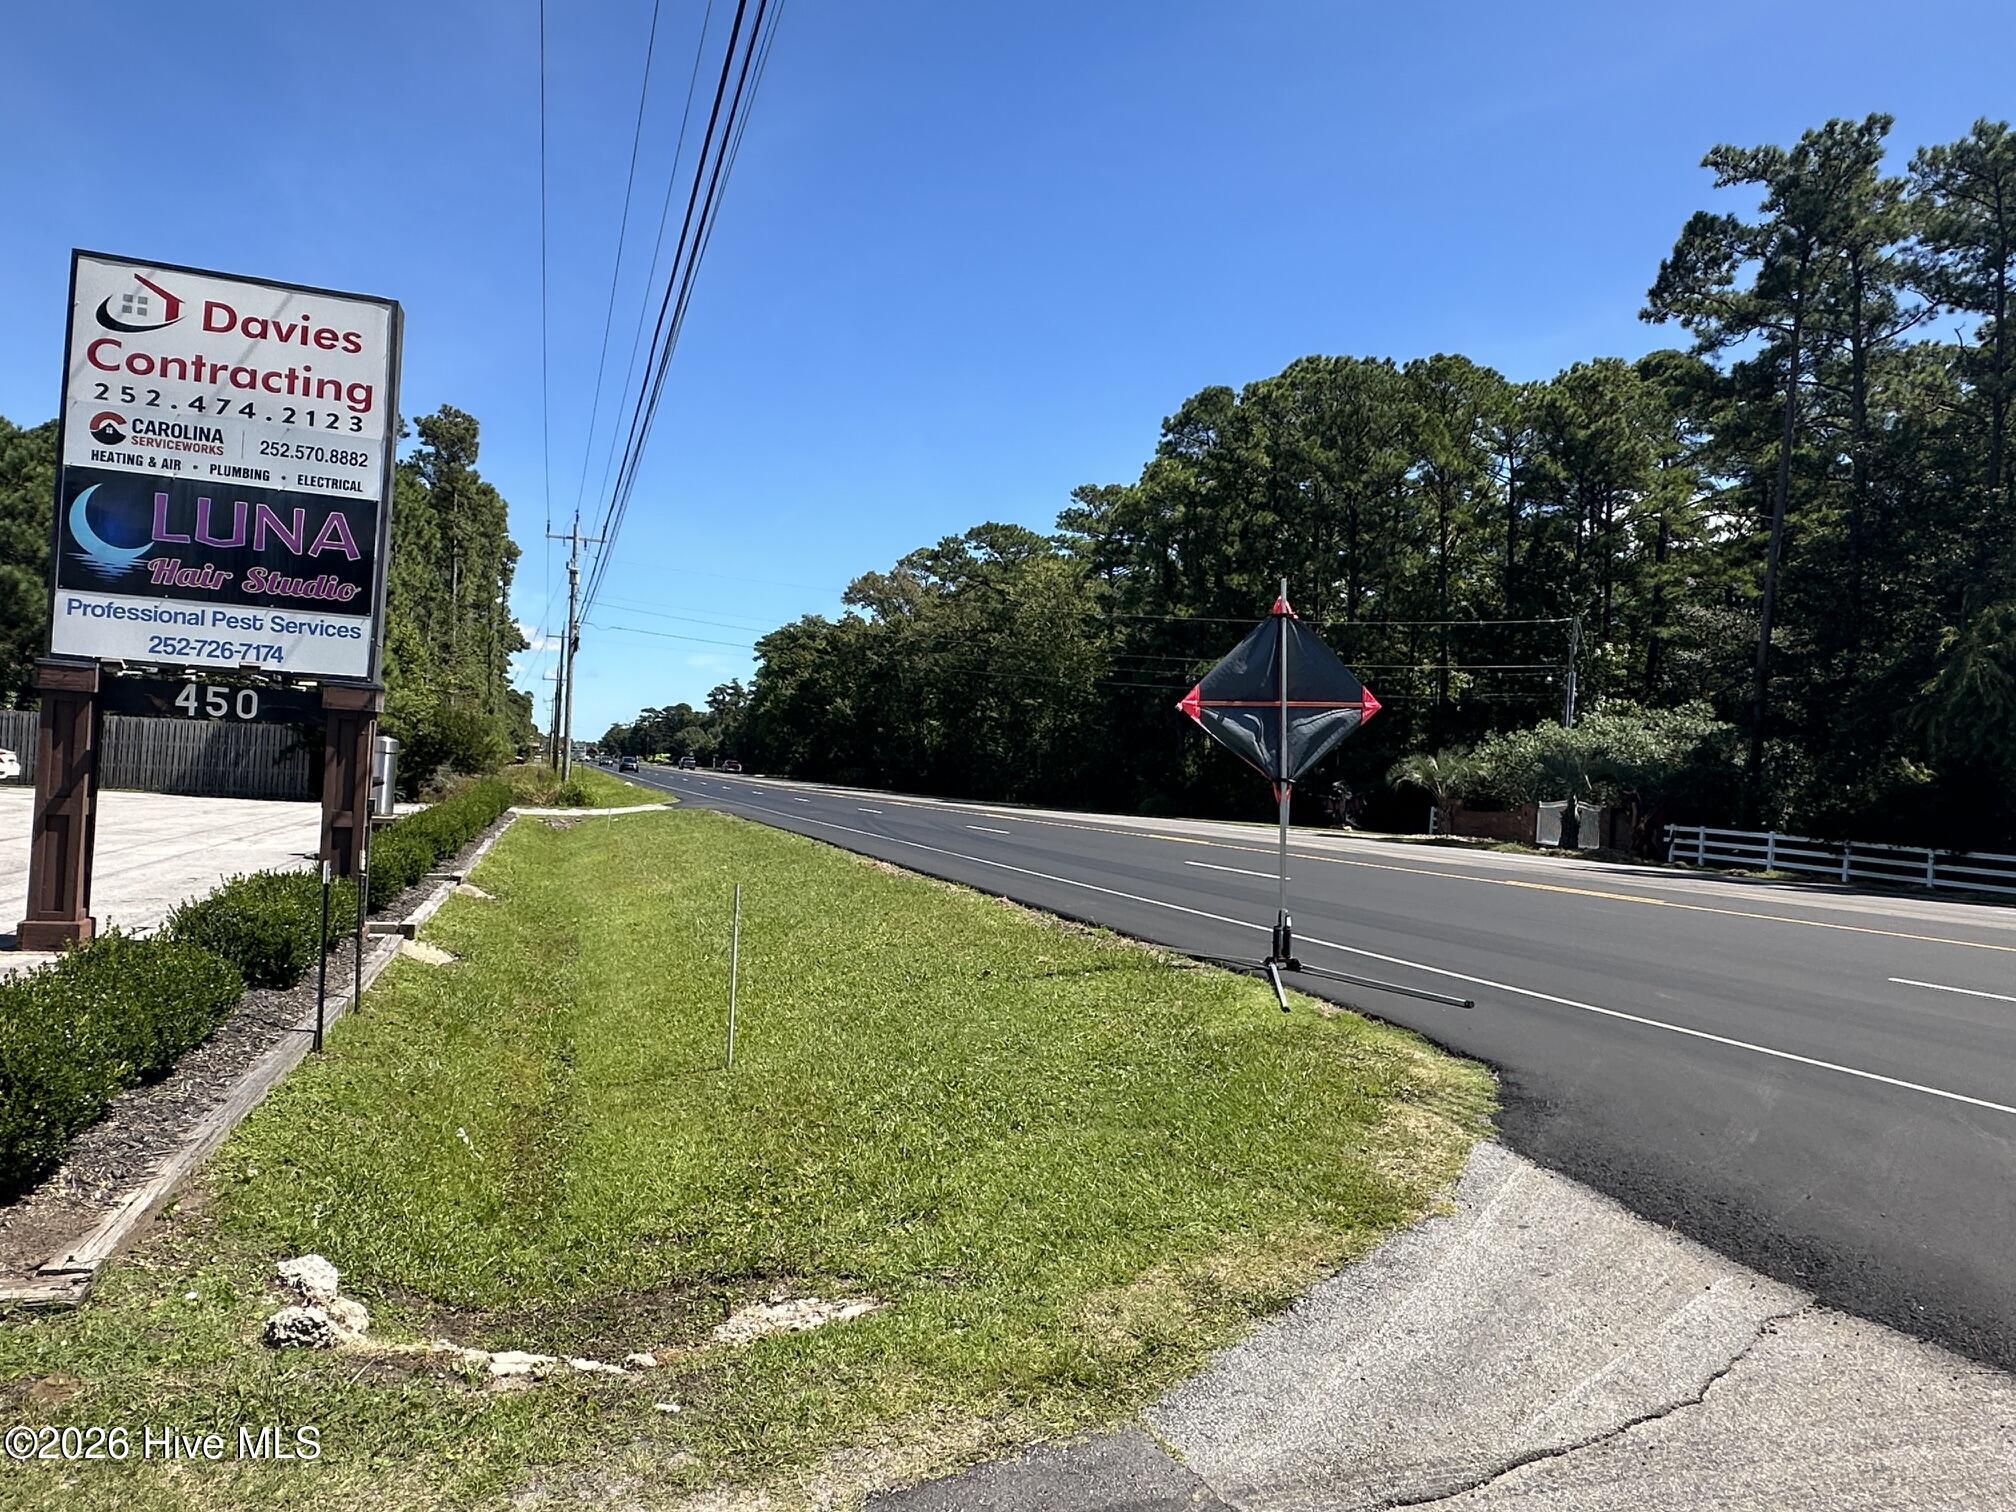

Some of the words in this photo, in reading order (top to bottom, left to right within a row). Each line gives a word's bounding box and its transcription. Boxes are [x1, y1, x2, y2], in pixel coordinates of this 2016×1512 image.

[202, 300, 363, 353] Davies
[87, 338, 373, 413] Contracting
[94, 382, 363, 432] 252.474.2123
[131, 435, 224, 456] SERVICEWORKS
[132, 418, 224, 444] CAROLINA
[91, 450, 143, 467] HEATING
[148, 456, 157, 468] &
[161, 457, 181, 471] AIR
[210, 463, 270, 482] PLUMBING
[297, 474, 363, 492] ELECTRICAL
[260, 441, 368, 468] 252.570.8882
[152, 492, 361, 561] LUNA
[148, 557, 233, 590] Hair
[242, 567, 362, 602] Studio
[66, 598, 205, 627] Professional
[212, 611, 264, 631] Pest
[271, 615, 361, 639] Services
[149, 635, 284, 663] 252-726-7174
[175, 683, 258, 719] 450
